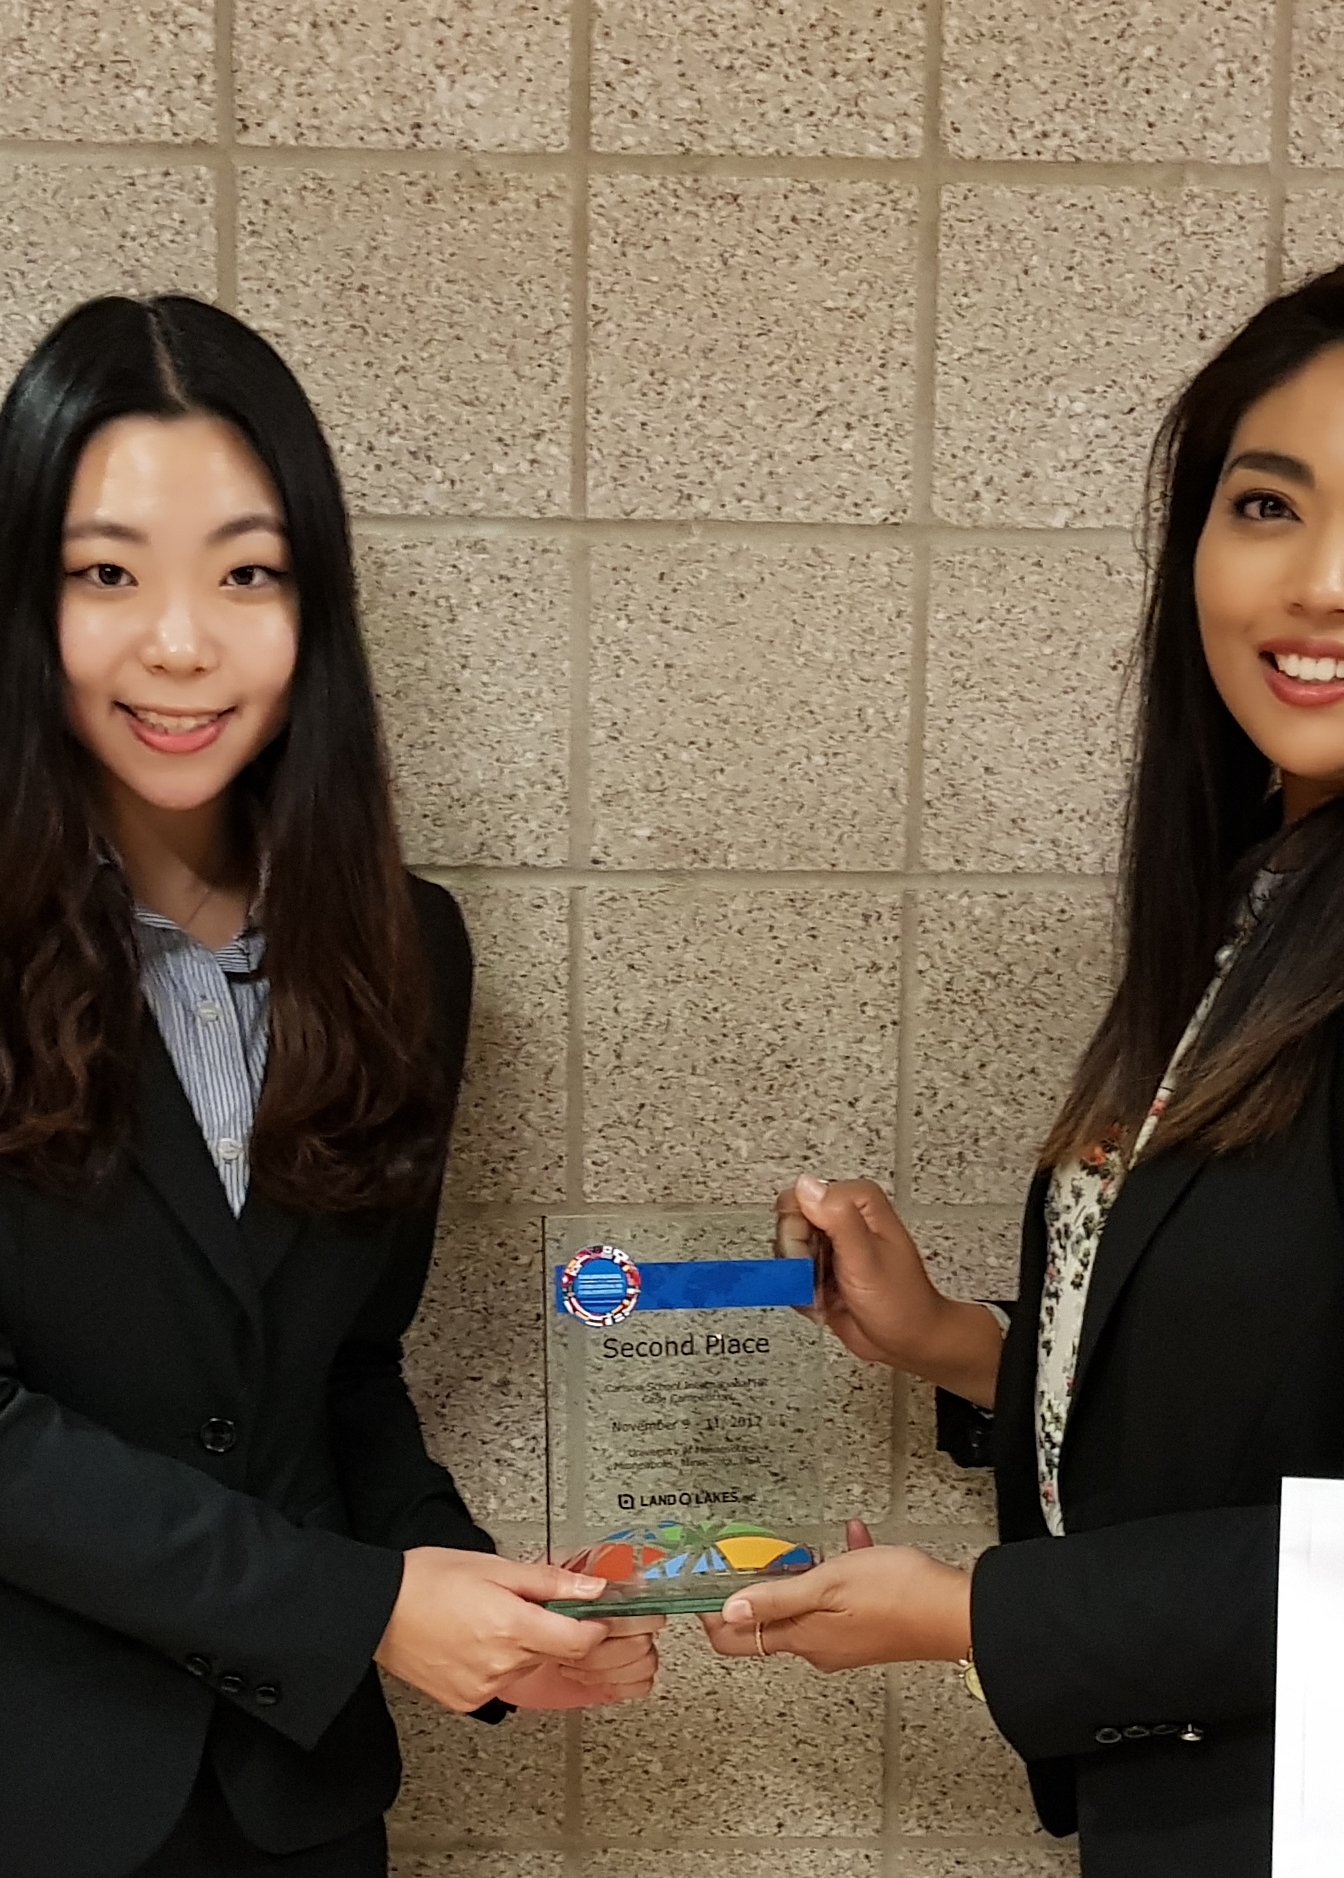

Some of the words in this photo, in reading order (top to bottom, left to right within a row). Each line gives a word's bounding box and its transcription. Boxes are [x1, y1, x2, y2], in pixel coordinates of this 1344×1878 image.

[603, 1333, 694, 1358] Second
[706, 1334, 770, 1355] Place
[612, 1420, 678, 1433] November
[640, 1494, 676, 1507] LAND
